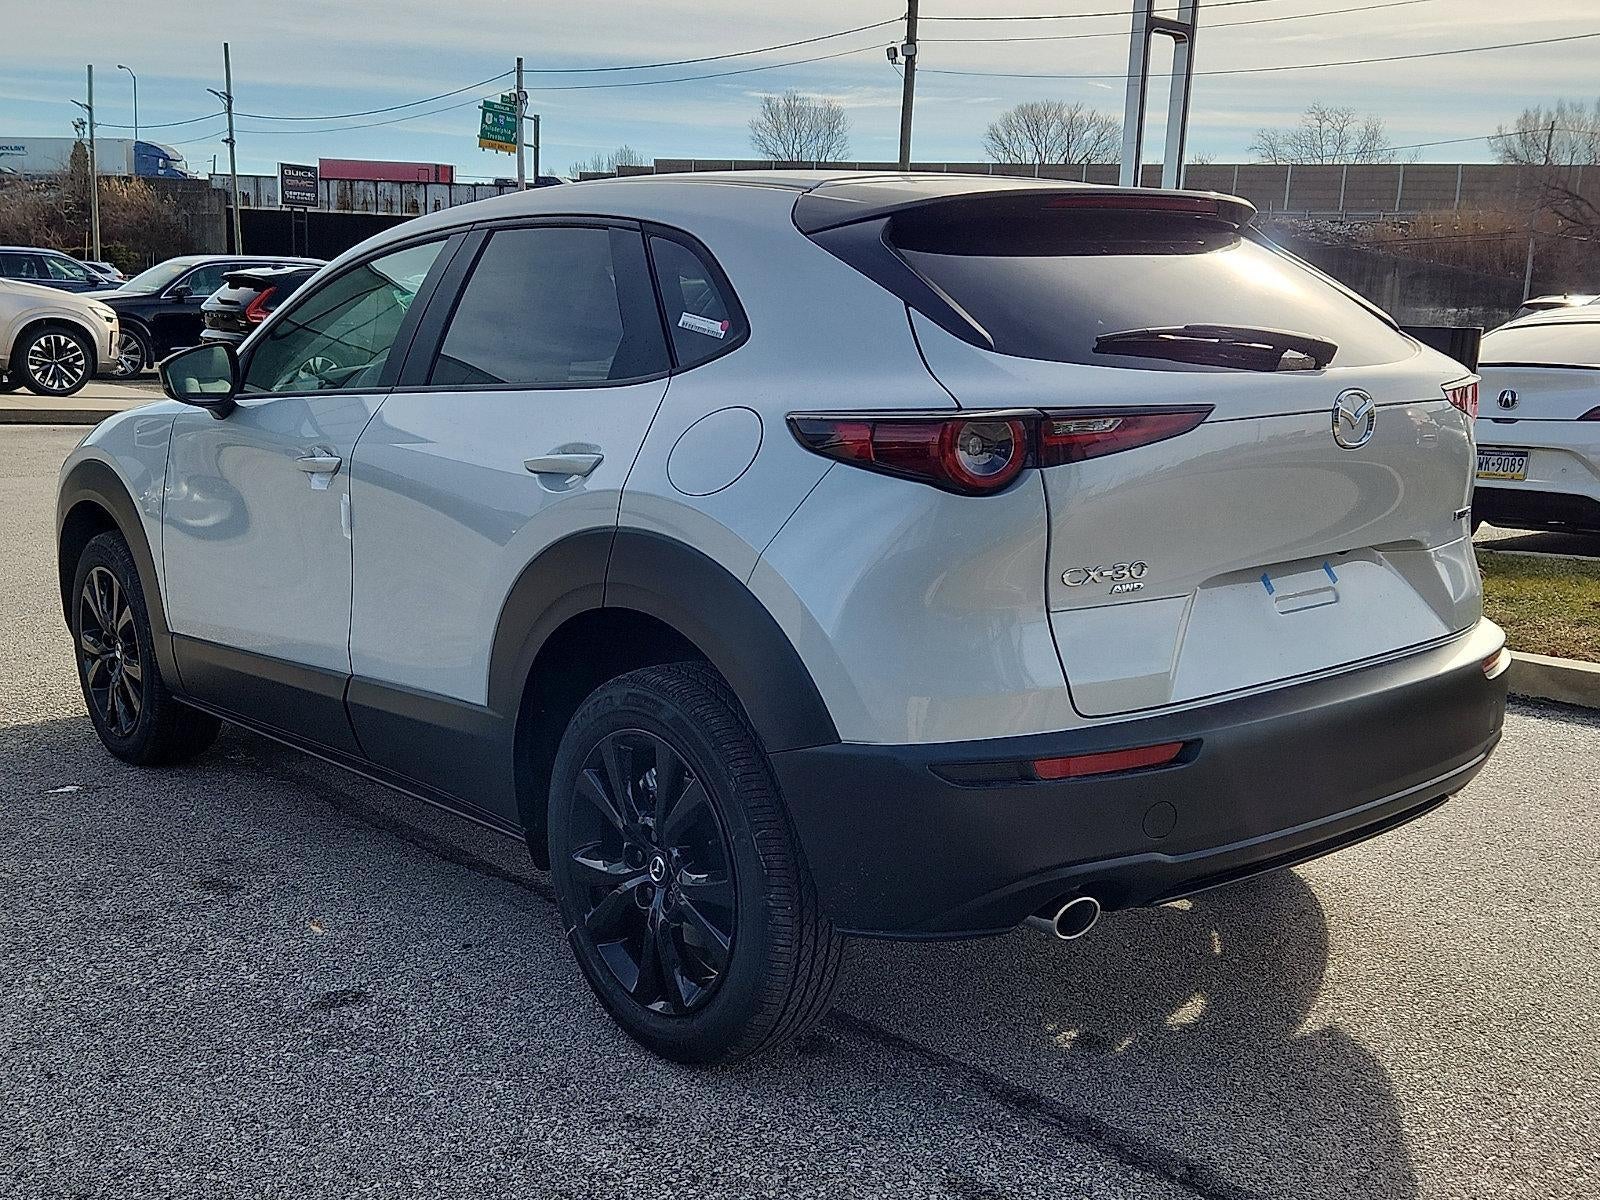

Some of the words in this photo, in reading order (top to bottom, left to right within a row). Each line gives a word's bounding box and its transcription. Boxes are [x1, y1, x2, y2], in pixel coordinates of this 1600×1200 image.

[284, 169, 315, 178] BUICK
[286, 179, 315, 187] GMC
[1061, 560, 1149, 587] CX-30
[1109, 582, 1145, 595] AWD
